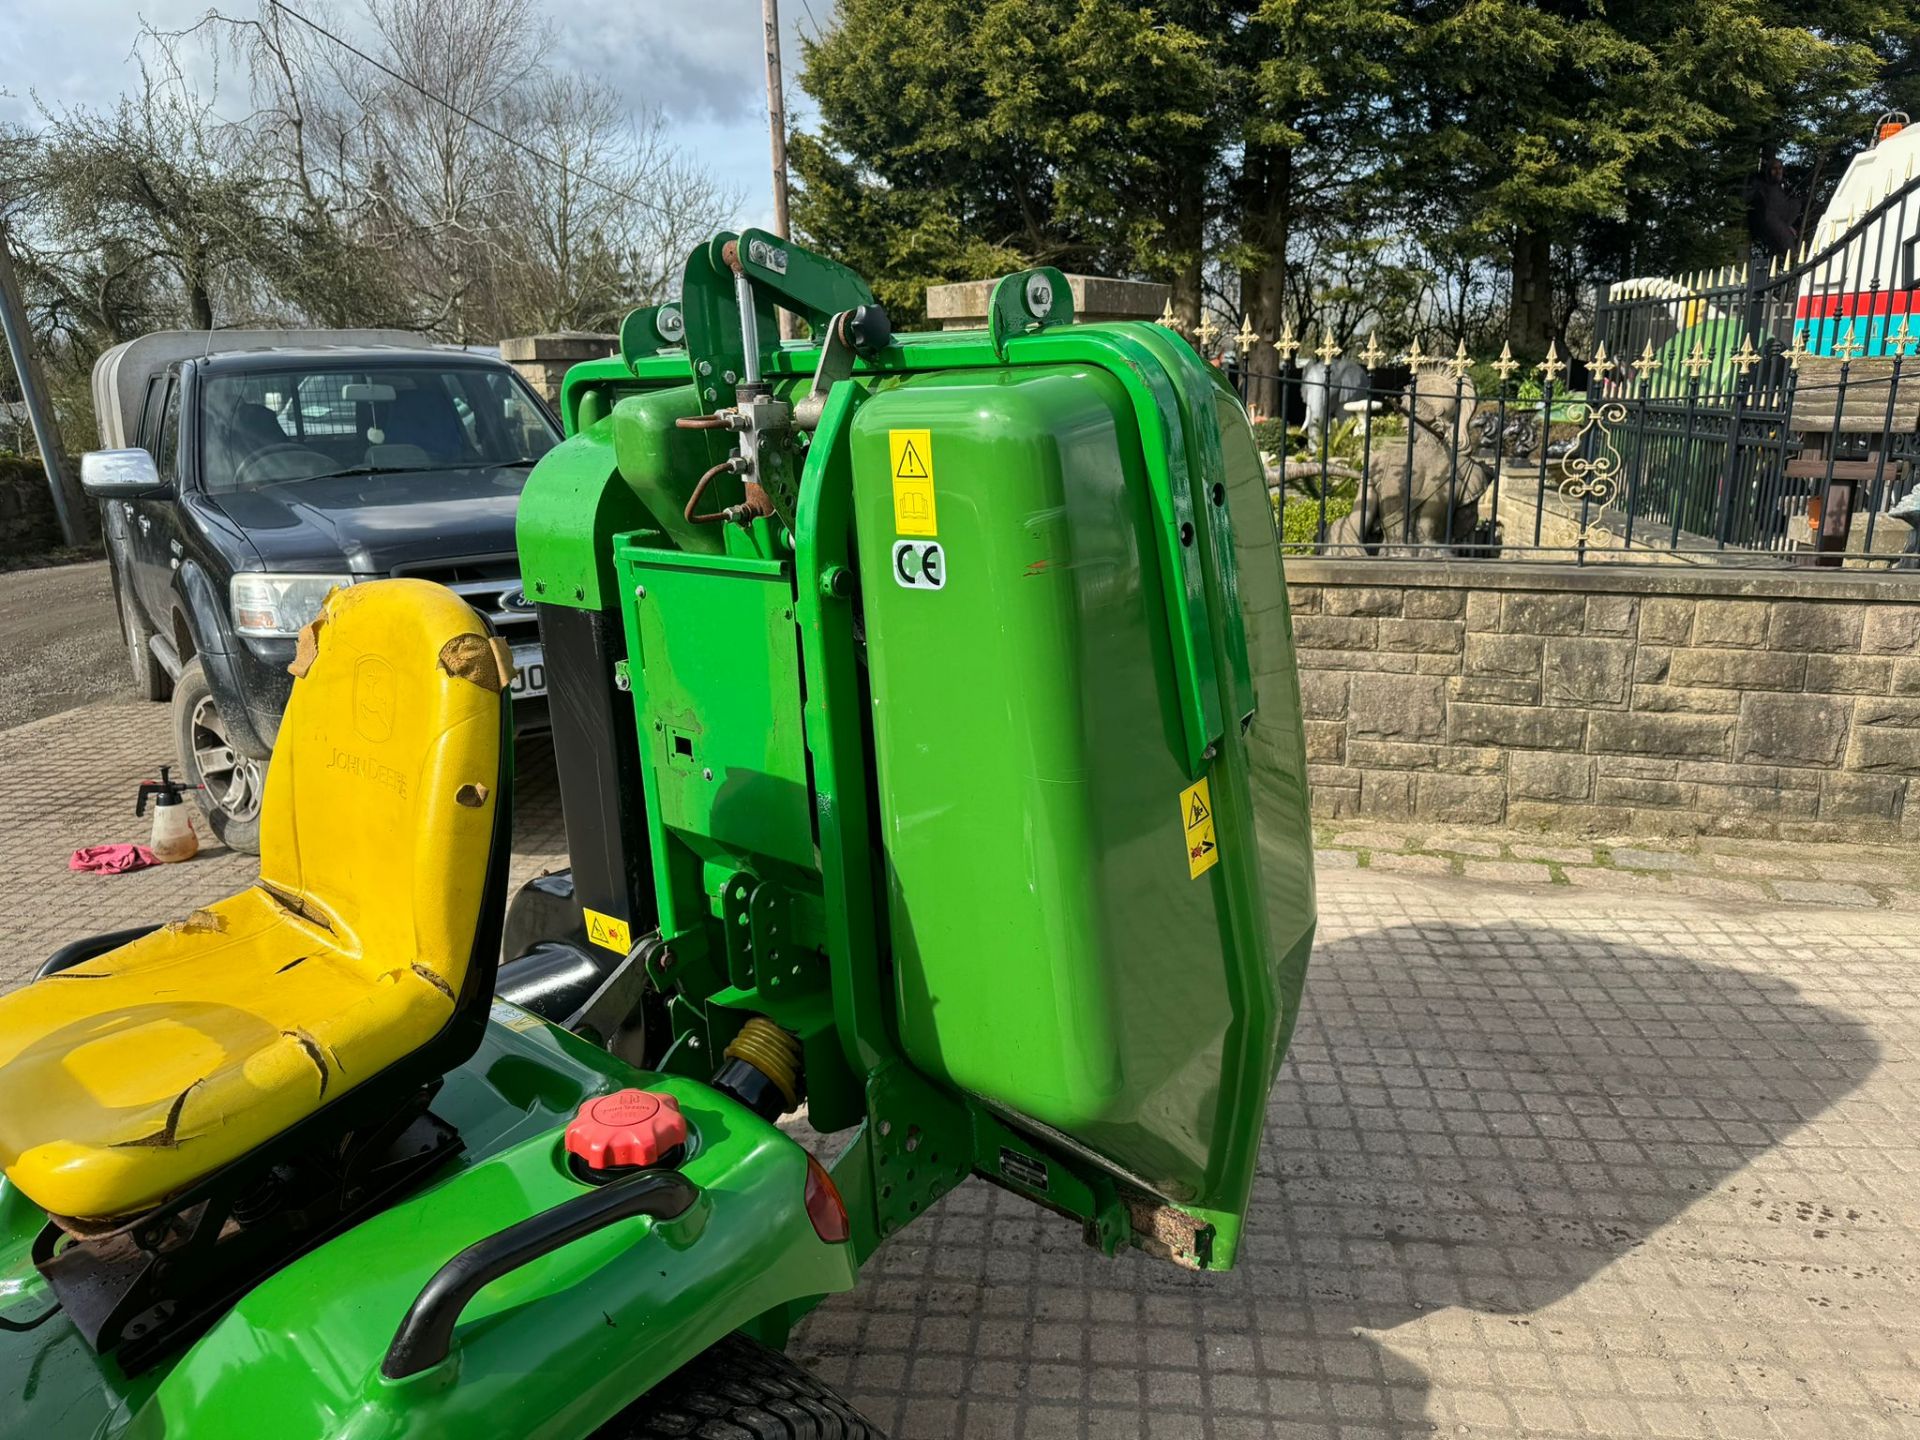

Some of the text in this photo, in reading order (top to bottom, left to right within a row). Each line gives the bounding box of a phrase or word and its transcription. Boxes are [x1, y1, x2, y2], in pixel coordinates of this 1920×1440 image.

[897, 544, 940, 586] CE
[326, 747, 407, 800] JOHN DEERE
